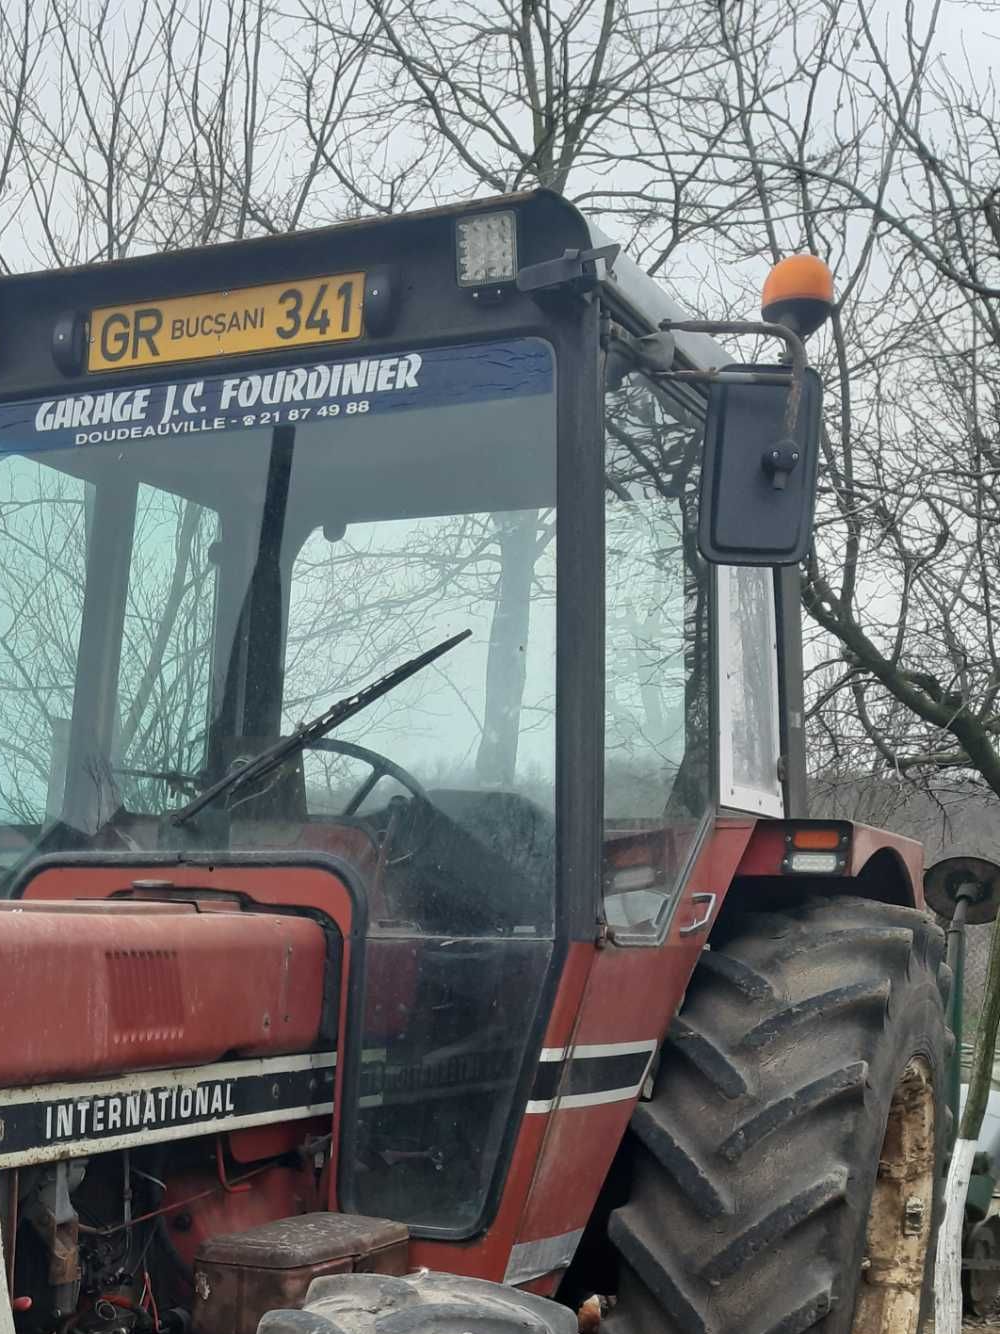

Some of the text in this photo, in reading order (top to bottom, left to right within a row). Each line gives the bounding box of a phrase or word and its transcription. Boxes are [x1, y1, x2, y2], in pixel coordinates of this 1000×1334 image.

[100, 308, 164, 362] GR
[276, 281, 354, 340] 341
[35, 353, 422, 432] GARAGE J.C. FOURDINIER
[75, 417, 226, 445] DOUDEAUVILLE
[260, 412, 280, 425] 21
[288, 408, 311, 421] 87
[317, 404, 340, 417] 49
[346, 400, 370, 414] 88
[44, 1083, 236, 1139] INTERNATIONAL
